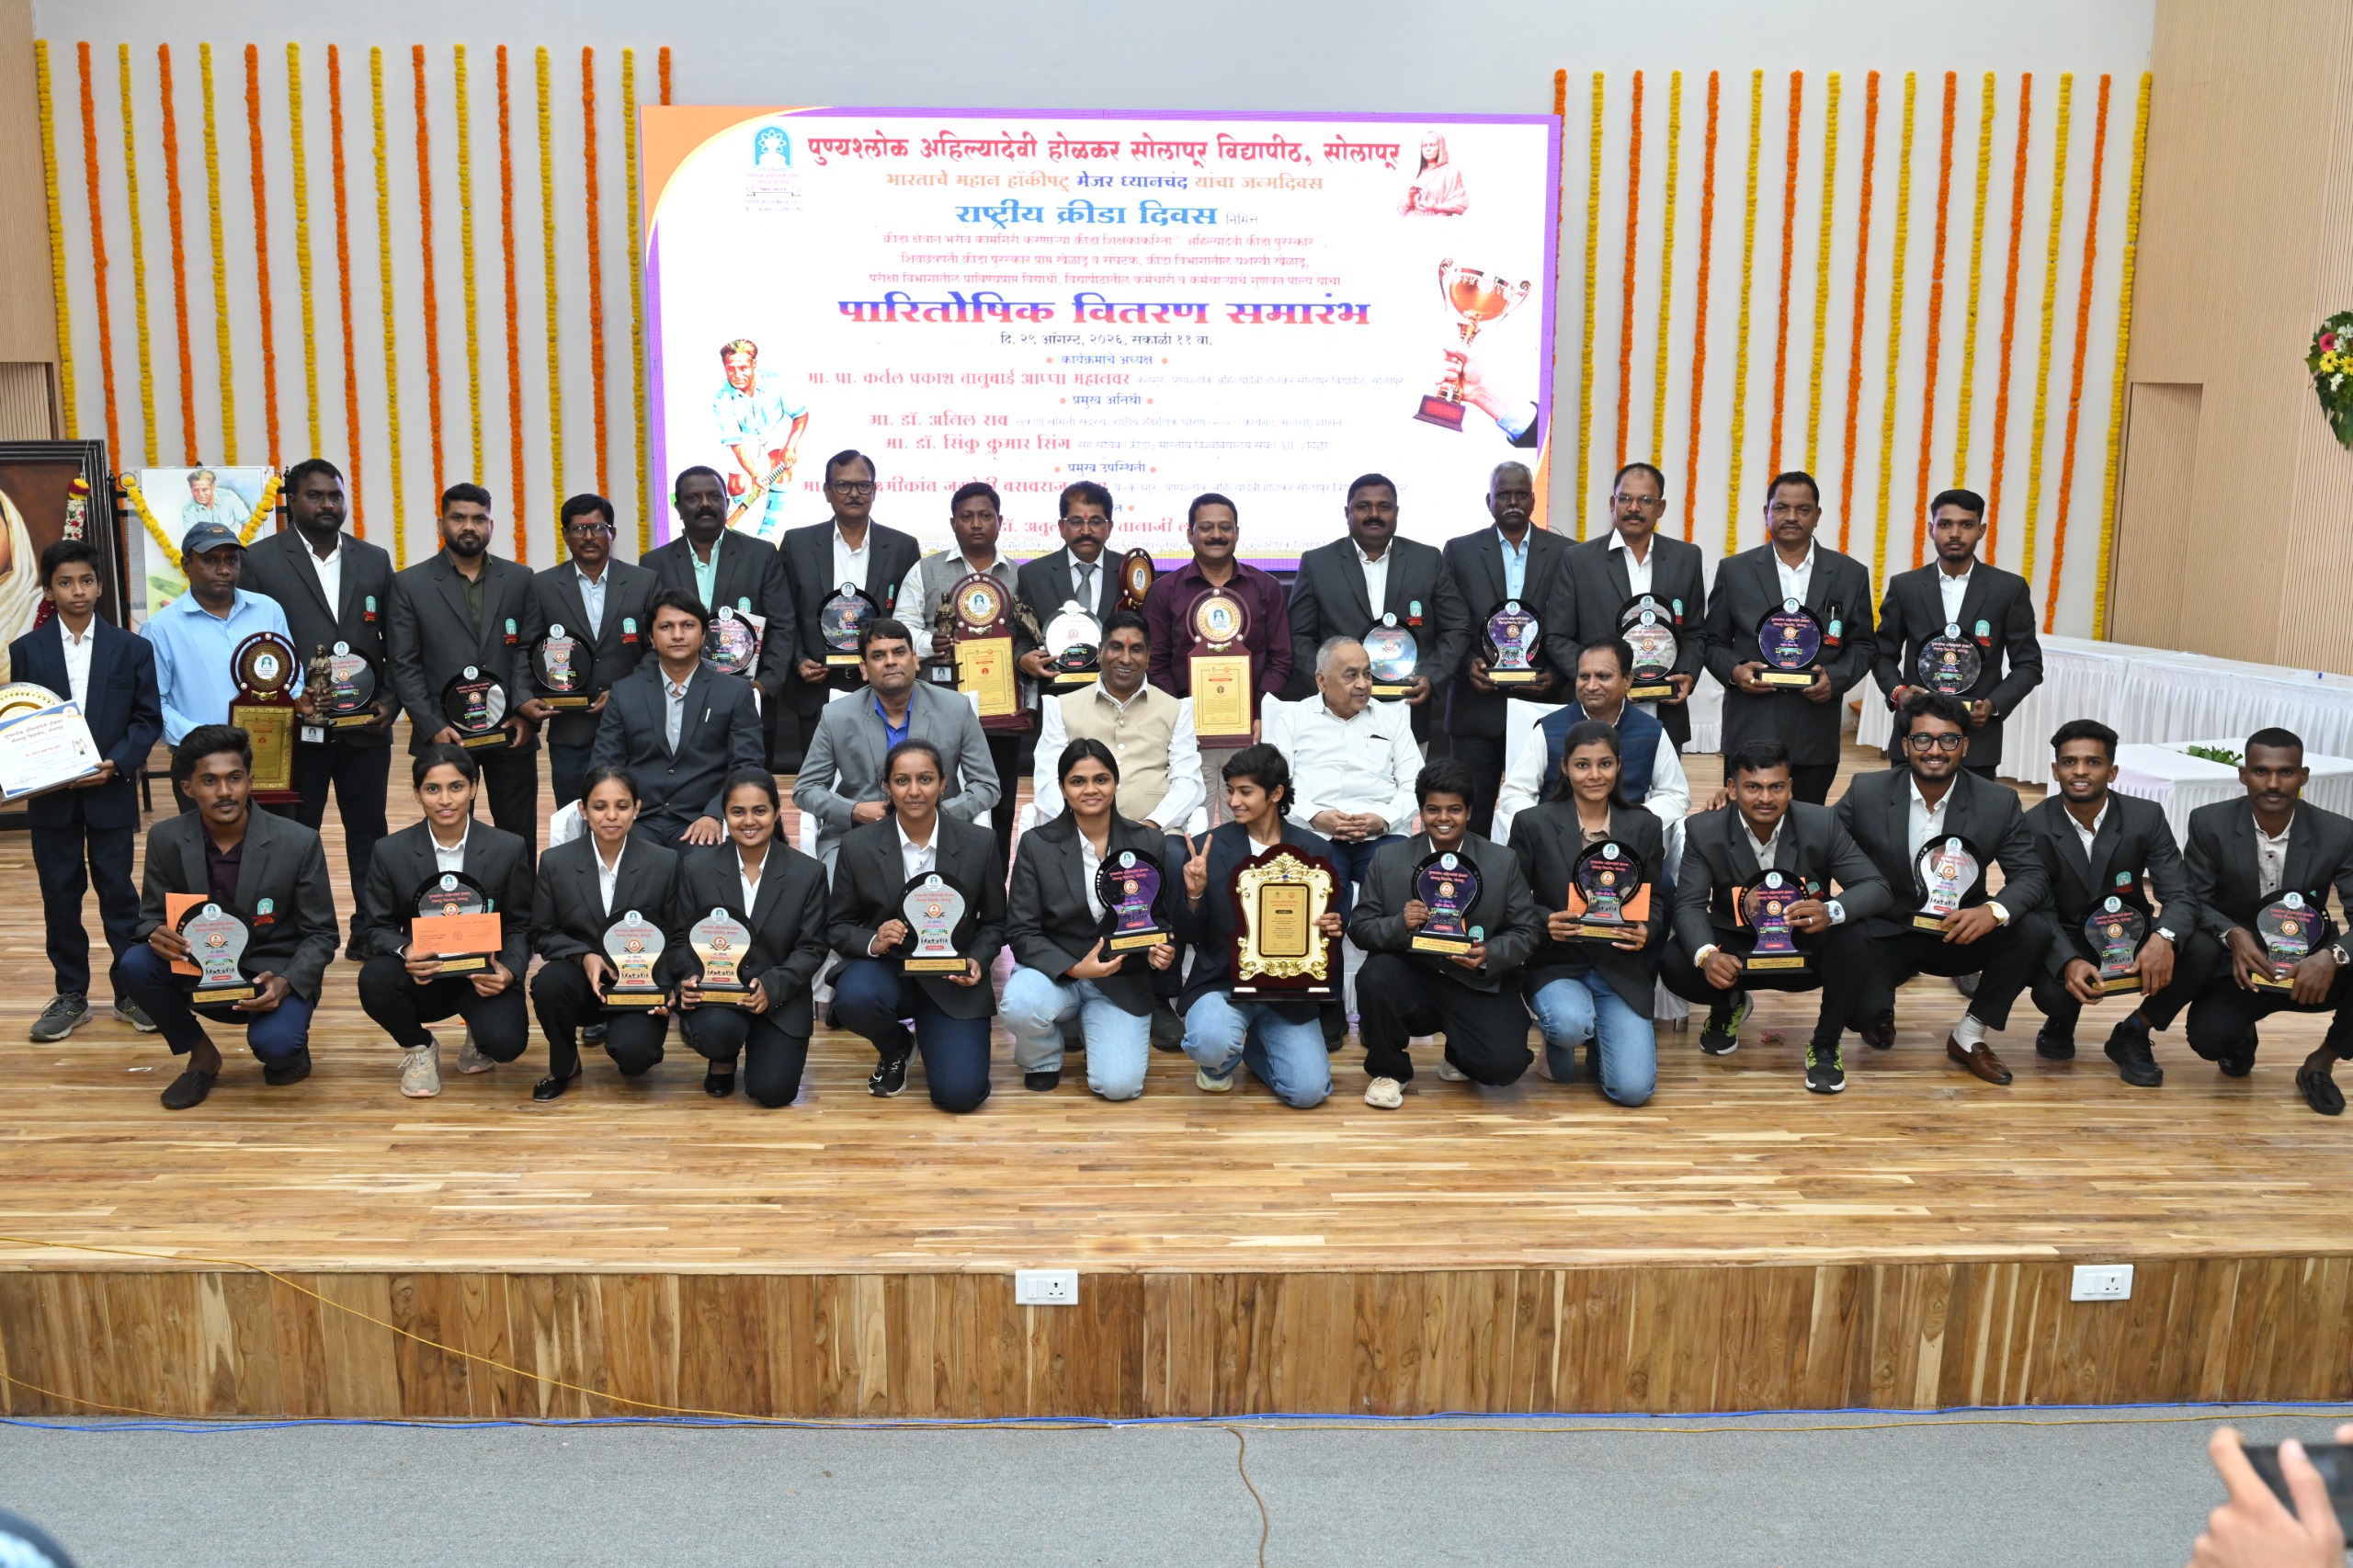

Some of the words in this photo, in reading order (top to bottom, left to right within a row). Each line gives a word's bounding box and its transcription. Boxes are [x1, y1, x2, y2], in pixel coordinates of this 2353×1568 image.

[808, 130, 909, 165] पुण्यश्लोक
[920, 130, 1038, 162] अहिल्यादेवी
[1048, 131, 1120, 163] होळकर
[1131, 132, 1208, 168] सोलापूर
[1216, 132, 1312, 165] विद्यापीठ,
[1324, 134, 1400, 170] सोलापूर
[887, 169, 948, 186] भारताचे
[956, 176, 1000, 187] महान
[1077, 171, 1113, 187] मेजर
[1121, 172, 1188, 189] ध्यानचंद
[1195, 172, 1233, 187] यांचा
[1242, 173, 1323, 190] जन्मदिवस
[955, 199, 1044, 229] राष्ट्रीय
[1057, 199, 1126, 223] क्रीडा
[1139, 199, 1218, 226] दिवस
[838, 291, 1055, 323] पारितोषिक
[1072, 292, 1210, 324] वितरण
[1225, 293, 1370, 324] समारंभ
[1001, 331, 1015, 344] दि.
[1131, 333, 1171, 344] सकाळी
[1177, 335, 1191, 345] ११
[1062, 352, 1115, 364] कार्यक्रमाचे
[1120, 356, 1152, 364] अध्यक्ष
[809, 373, 828, 383] मा.
[910, 373, 954, 384] प्रकाश
[1073, 396, 1101, 409] प्रमुख
[1107, 392, 1141, 404] अतिथी
[870, 415, 892, 426] मा.
[902, 412, 921, 426] डॉ.
[983, 415, 1007, 426] राव
[886, 438, 907, 449] मा.
[916, 436, 936, 449] डॉ.
[987, 438, 1029, 454] कुमार
[1038, 434, 1070, 449] सिंग
[1068, 464, 1096, 476] प्रमुख
[1099, 460, 1145, 472] उपस्थिती
